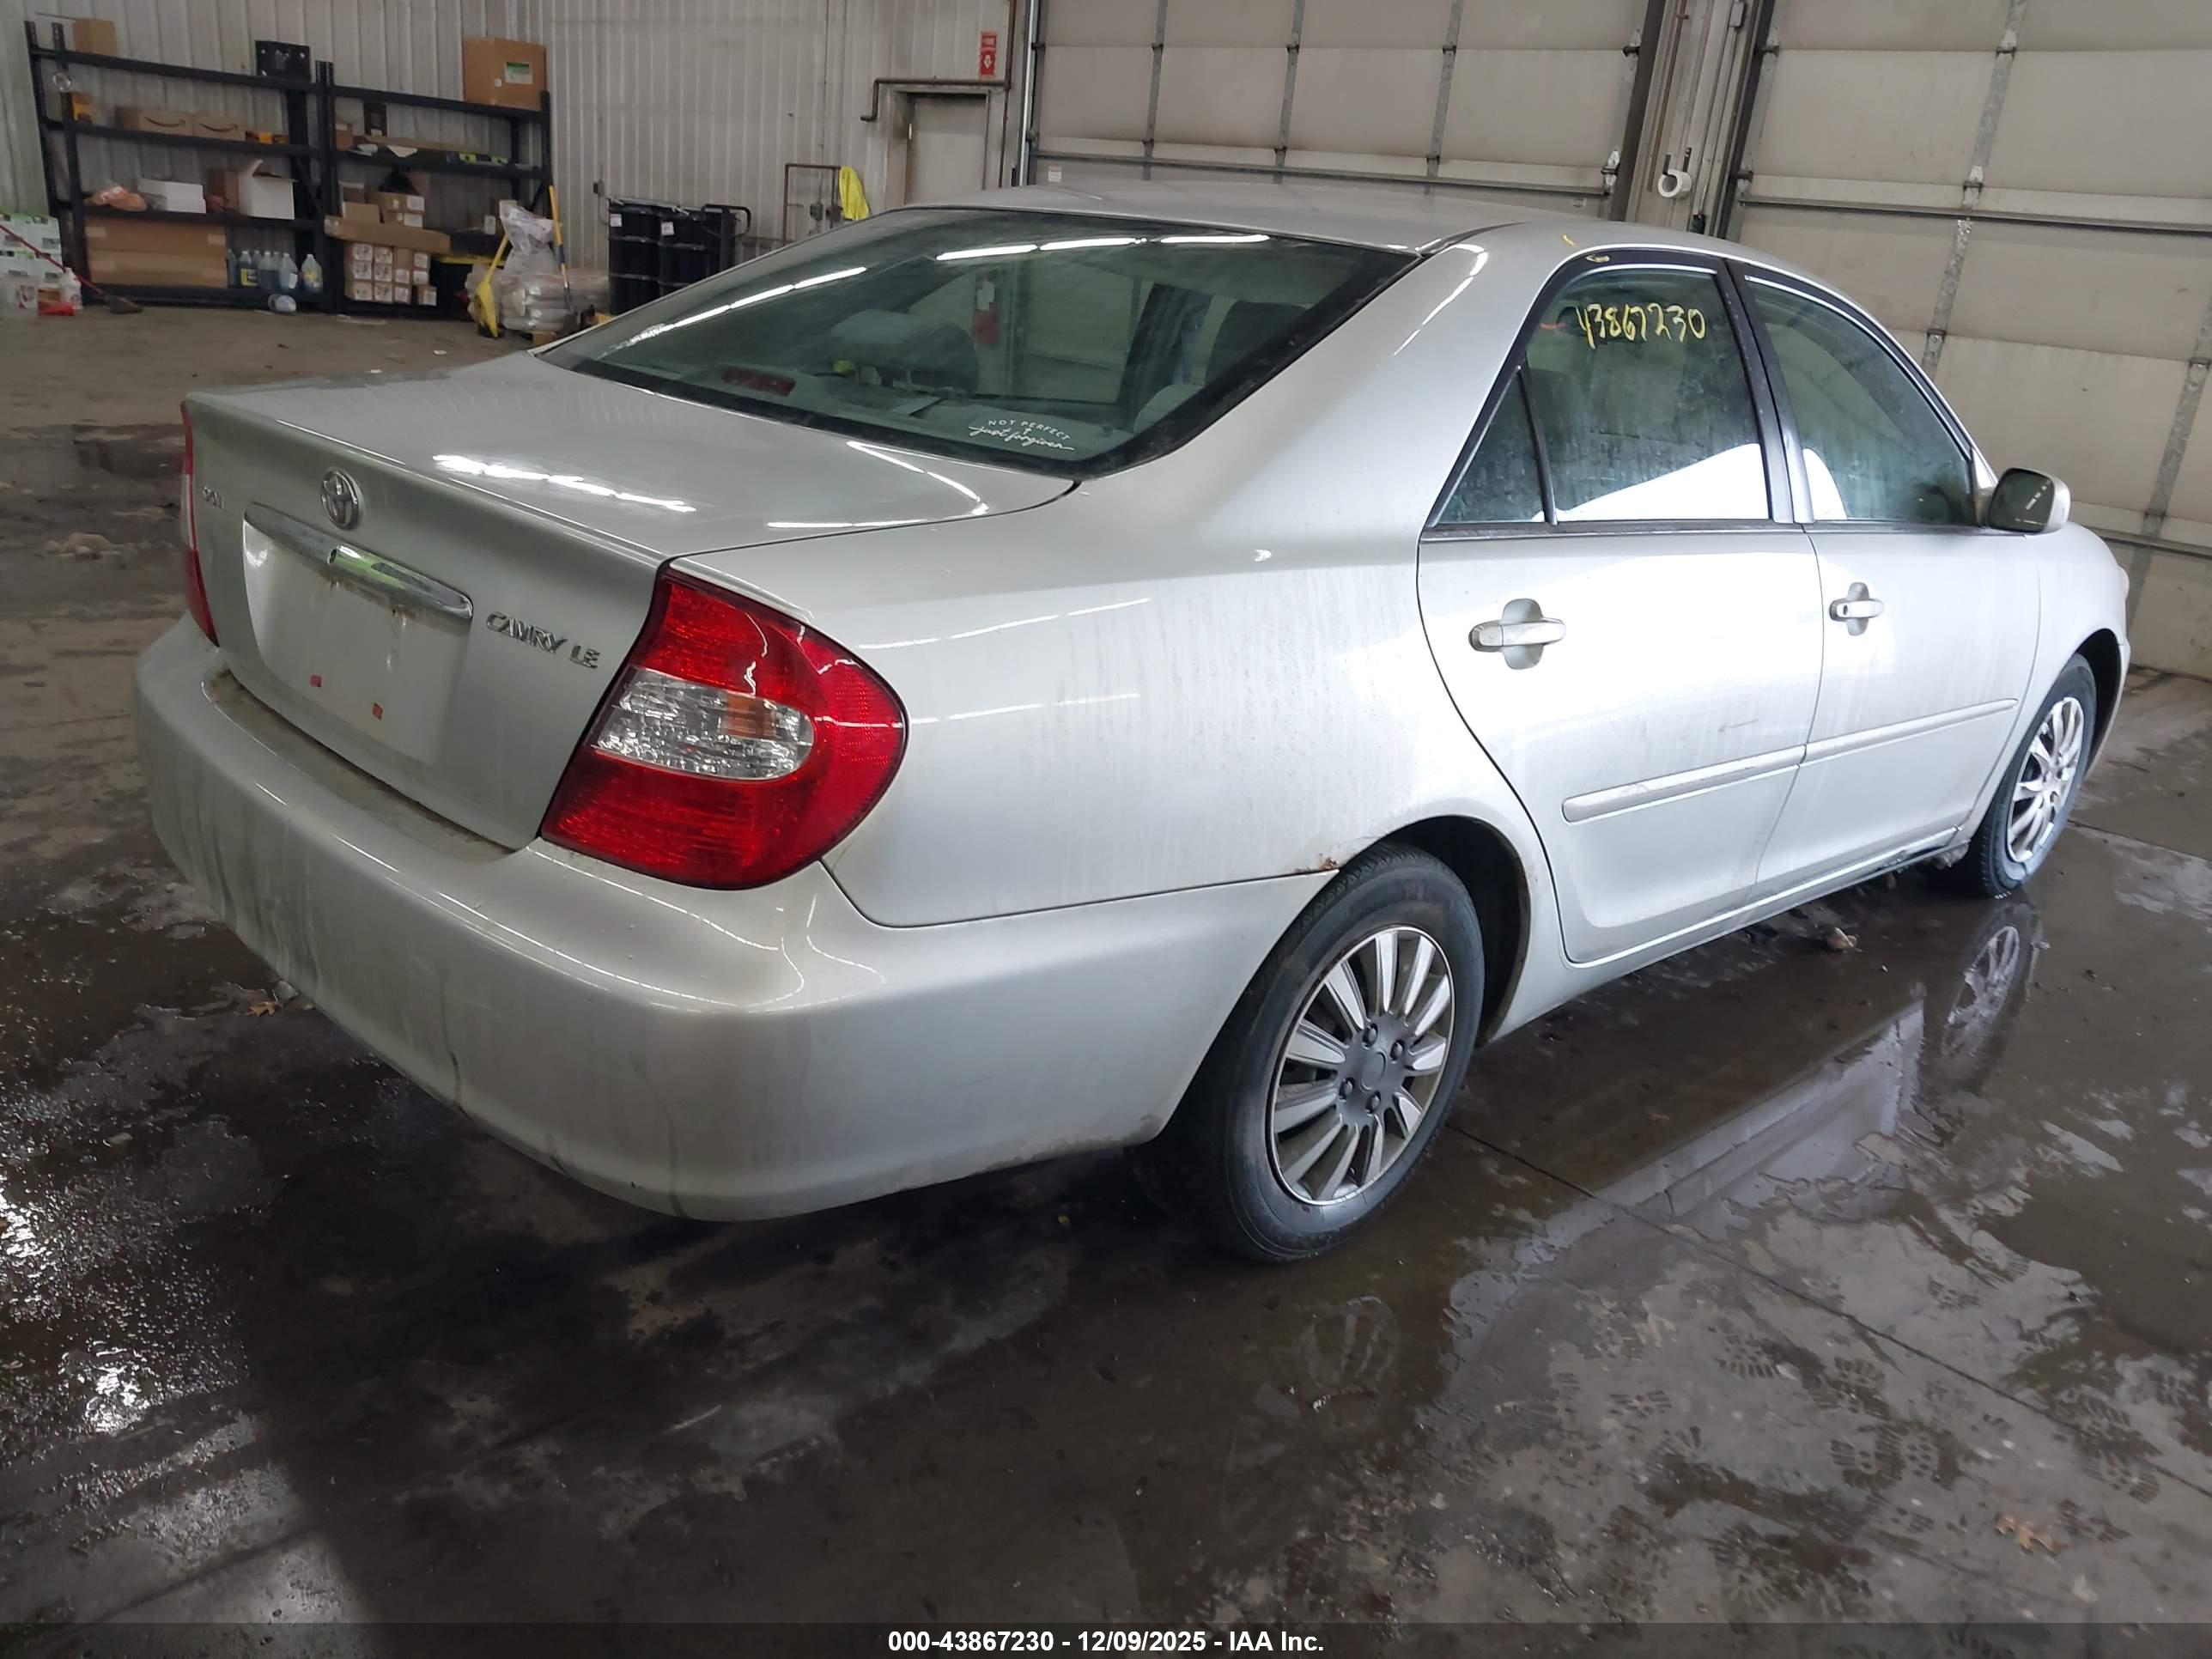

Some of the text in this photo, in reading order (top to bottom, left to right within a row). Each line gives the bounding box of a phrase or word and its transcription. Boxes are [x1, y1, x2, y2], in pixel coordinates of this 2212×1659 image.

[1575, 302, 1707, 349] 43867230
[969, 425, 1075, 451] just forgiven
[1020, 421, 1071, 441] PERFECT
[486, 611, 600, 669] CAMRY LE
